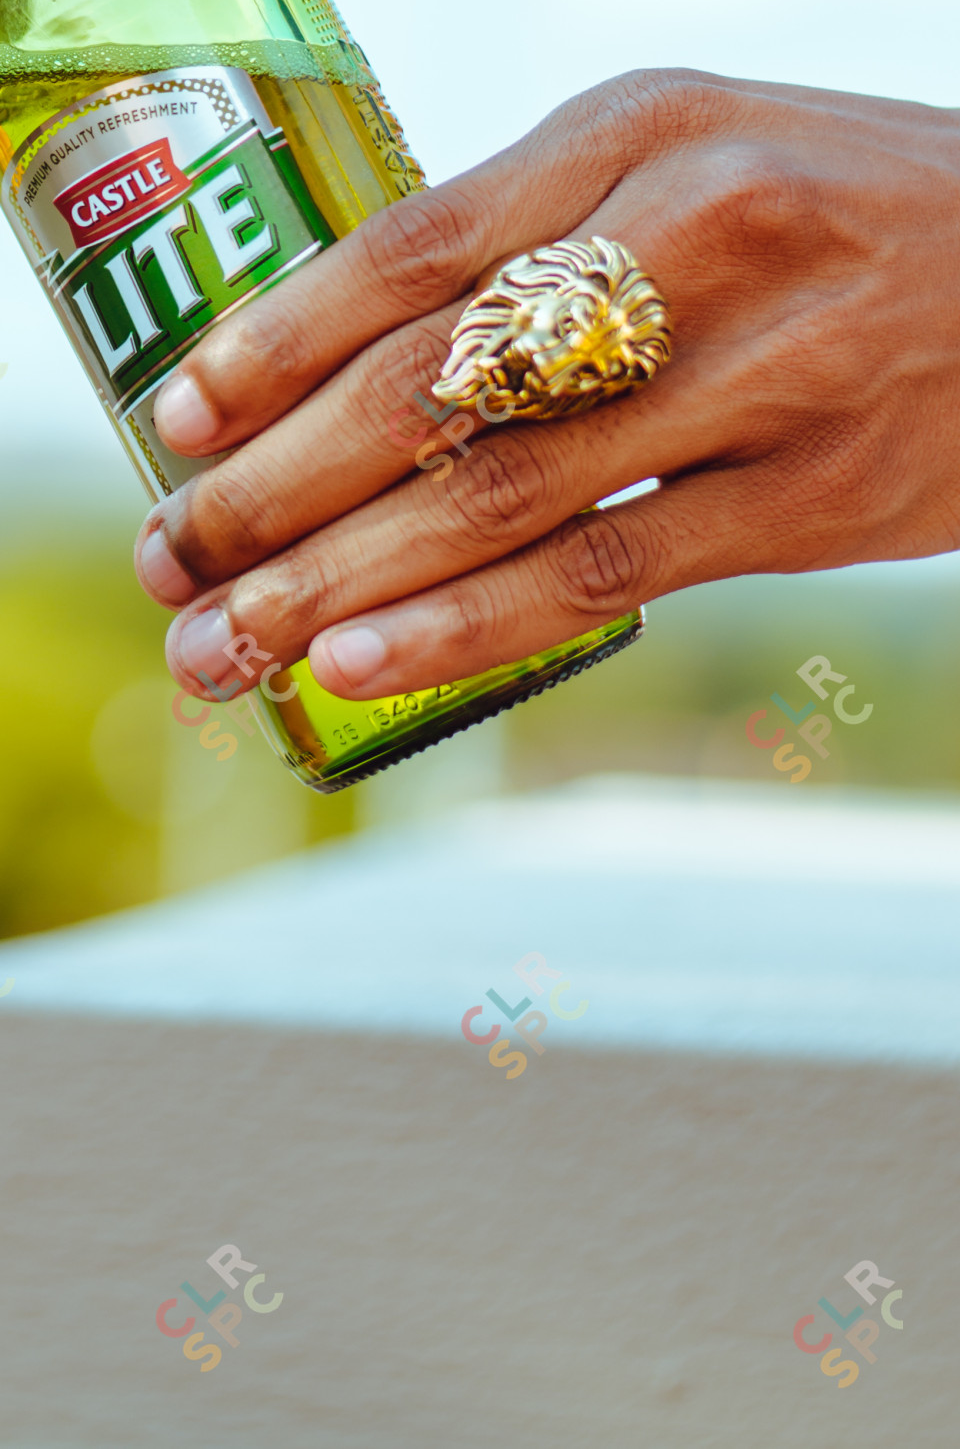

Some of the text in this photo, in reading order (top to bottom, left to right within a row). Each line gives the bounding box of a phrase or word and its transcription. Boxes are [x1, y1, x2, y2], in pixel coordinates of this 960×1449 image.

[23, 101, 198, 208] PREMIUM QUALITY REFRESHMENT
[71, 158, 172, 229] CASTLE
[72, 164, 279, 378] LITE
